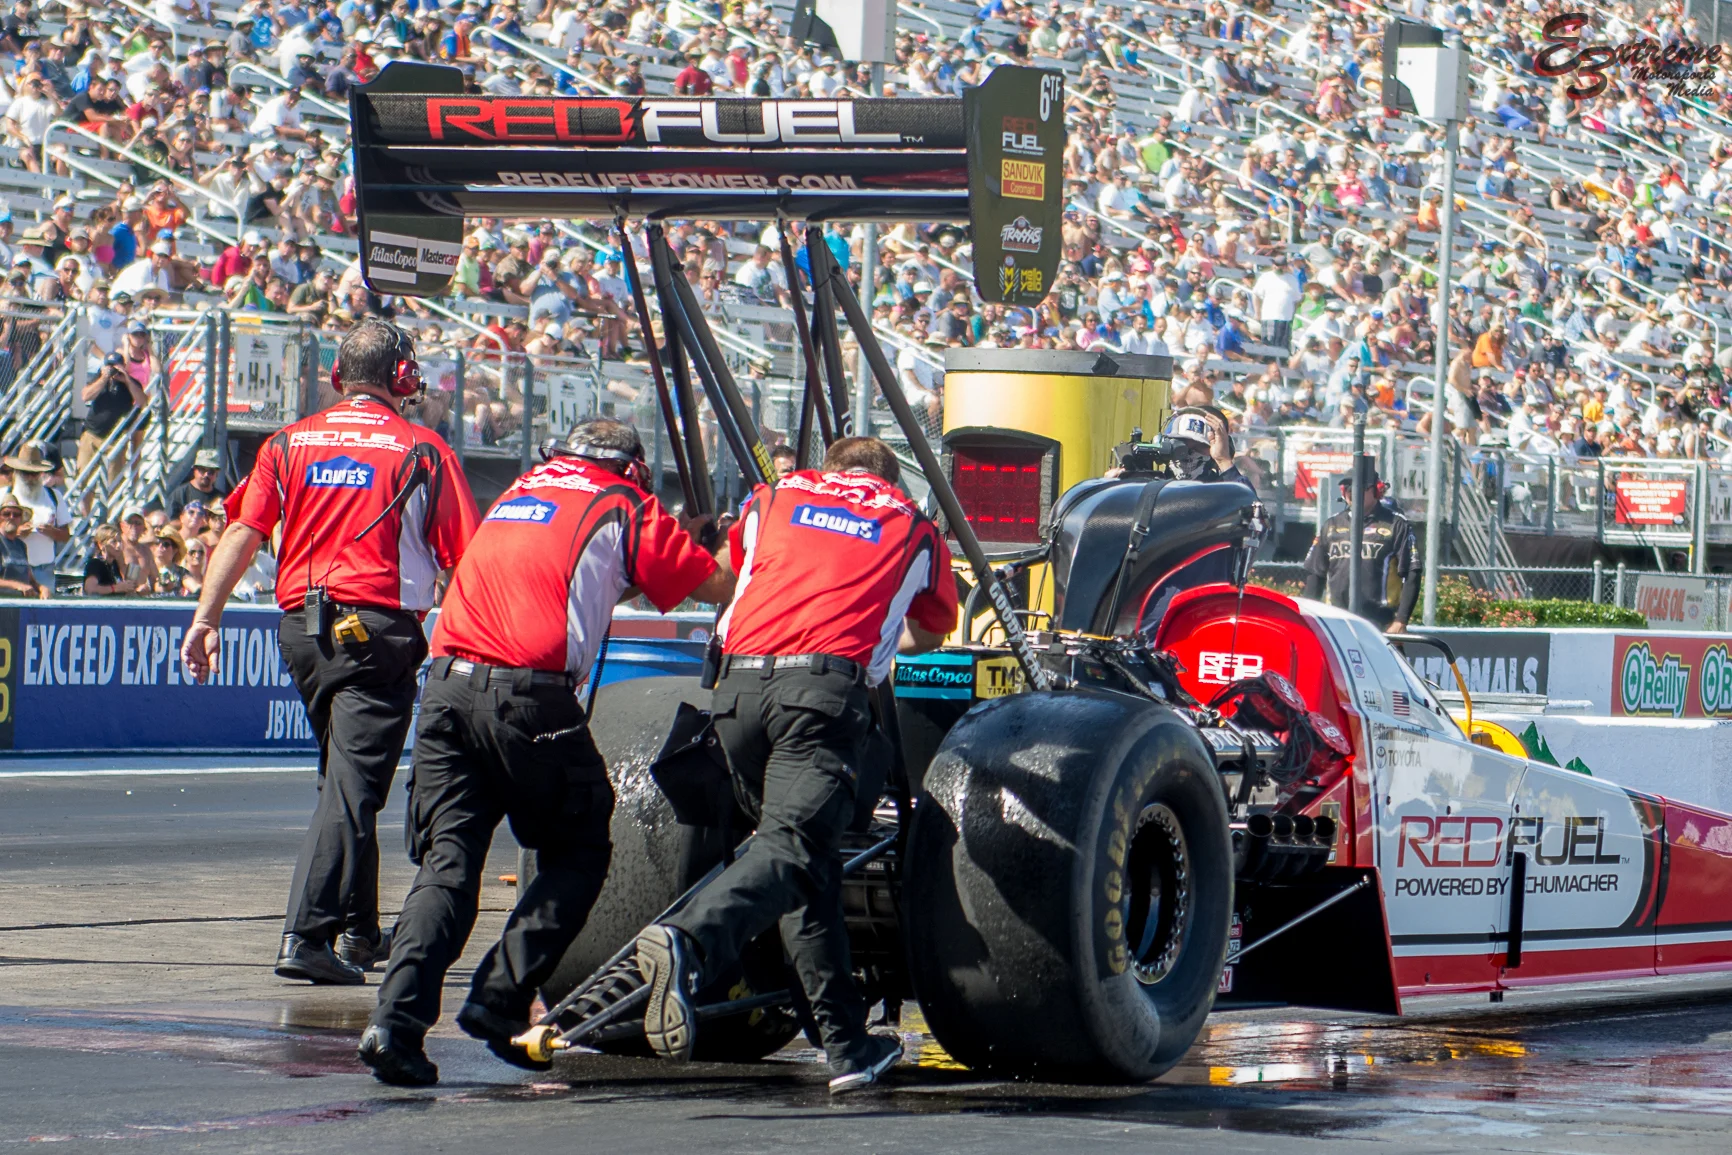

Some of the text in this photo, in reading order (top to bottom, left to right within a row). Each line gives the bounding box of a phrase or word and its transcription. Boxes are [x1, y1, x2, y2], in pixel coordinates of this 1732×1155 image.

[427, 98, 635, 141] RED
[641, 101, 901, 142] FUEL
[1002, 116, 1037, 134] RED
[1002, 132, 1044, 150] FUEL
[1003, 161, 1043, 182] SANDVIK
[1010, 182, 1036, 195] Coromant
[1000, 227, 1043, 244] TRAXXAS
[369, 246, 417, 269] Atlas Copco
[312, 466, 369, 486] LOWE'S
[1328, 540, 1384, 560] ARY
[1637, 586, 1686, 622] LUCAS OIL
[24, 625, 116, 686] EXCEED
[121, 626, 292, 687] EXPEATION
[1199, 651, 1263, 667] RED
[895, 665, 973, 686] Atlas Copco
[1404, 656, 1539, 694] ATIONALS
[1623, 646, 1689, 718] O'Reilly
[1221, 729, 1279, 747] TOOTA
[1388, 749, 1422, 768] TOYOTA
[1396, 816, 1503, 867] RED
[1505, 817, 1621, 867] FUEL
[1395, 874, 1619, 896] POWERED BY CHUMACHER
